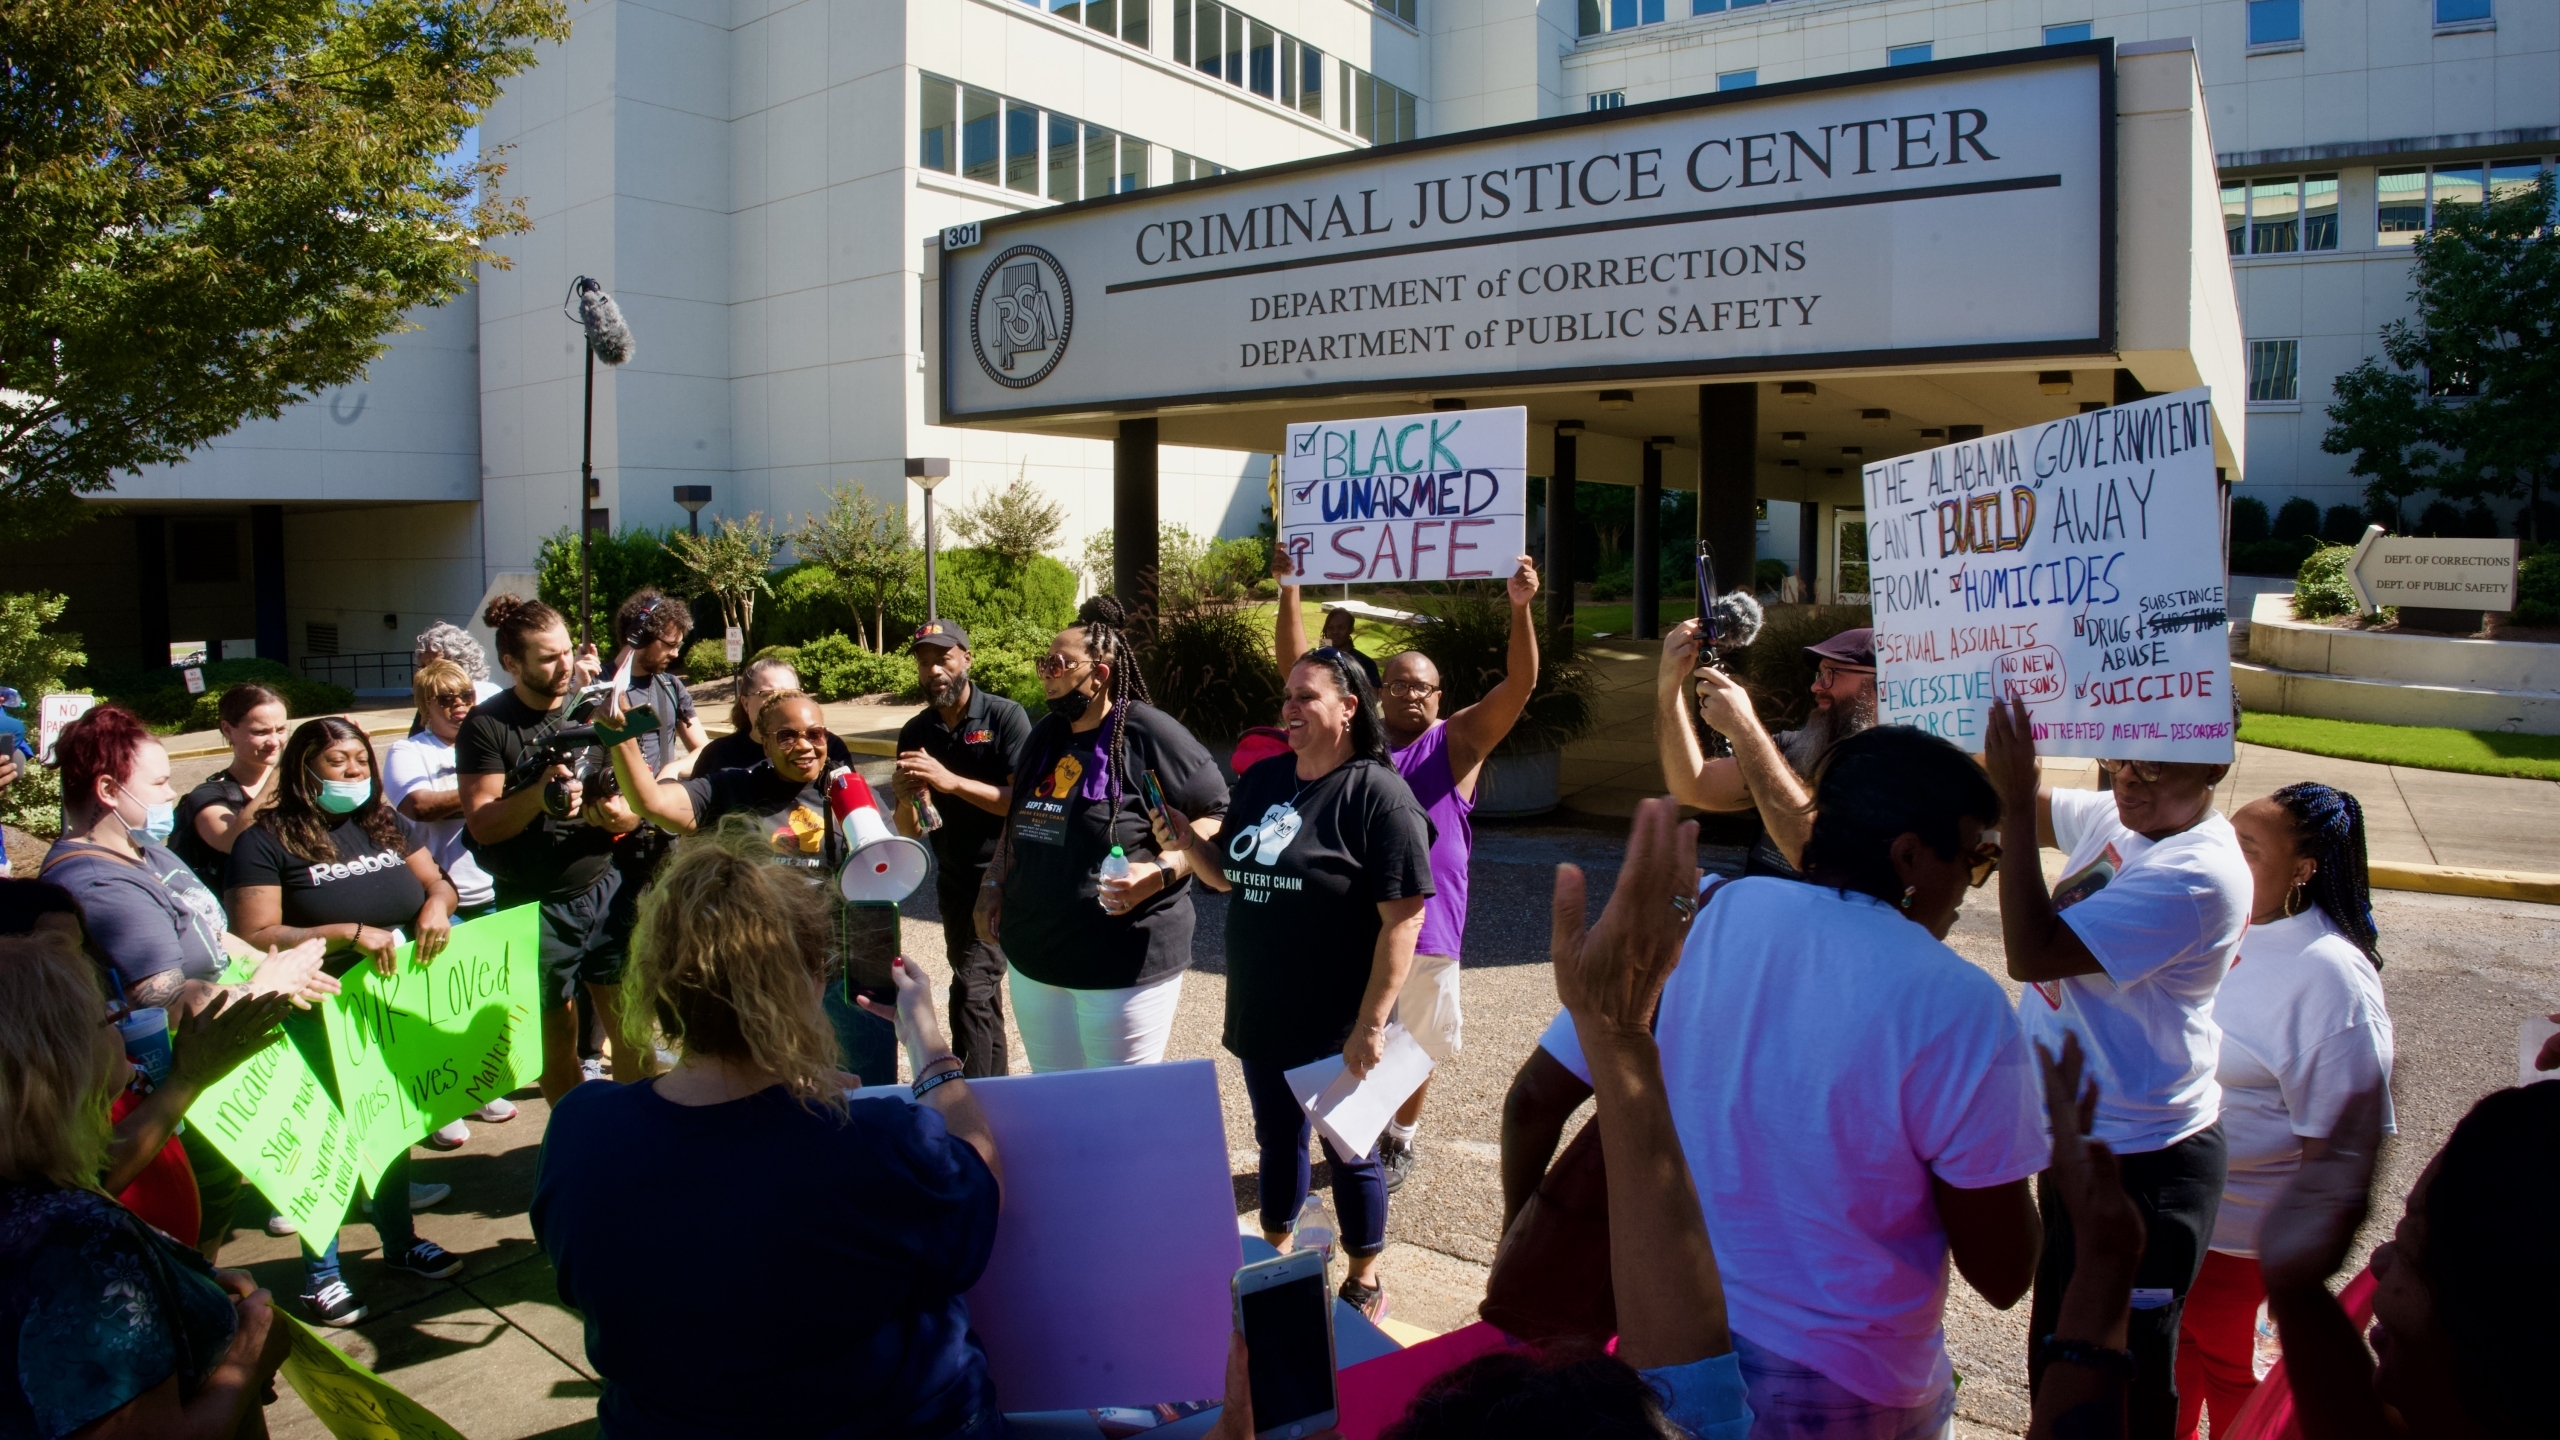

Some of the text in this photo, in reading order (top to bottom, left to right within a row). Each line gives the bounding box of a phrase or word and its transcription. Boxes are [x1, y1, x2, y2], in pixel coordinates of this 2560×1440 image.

[1136, 108, 2000, 266] CRIMINAL JUSTICE CENTER
[948, 227, 979, 247] 301
[1250, 240, 1806, 323] DEPARTMENT of CORRECTIONS
[1240, 295, 1821, 369] DEPARTMENT of PUBLIC SAFETY
[1324, 418, 1462, 479] BLACK
[1865, 399, 2211, 509] THE ALABAMA GOVERNMENT
[1321, 469, 1499, 523] UNARMED
[1868, 509, 1928, 562] CAN'T
[2053, 469, 2155, 544] AWAY
[1323, 519, 1495, 580] SAFE
[2384, 555, 2510, 567] DEPT. OF CORRECTIONS
[1872, 552, 2125, 615] FROM: HOMICIDES
[2139, 587, 2223, 613] SUBSTANCE
[2376, 579, 2509, 593] DEPT. OF PUBLIC SAFETY
[1885, 623, 2038, 664] SEXUAL ASSUALTS
[2086, 615, 2131, 649] DRUG
[2001, 652, 2054, 673] NO NEW
[2101, 641, 2170, 673] ABUSE
[1888, 671, 1994, 711] EXCESSIVE
[2004, 674, 2059, 700] PRISONS
[2089, 670, 2214, 707] SUICIDE
[59, 704, 78, 717] NO
[2112, 722, 2168, 741] MENTAL
[2171, 722, 2231, 742] DISORDERS
[1025, 801, 1063, 813] SEPT 26TH
[309, 849, 406, 886] Reebok
[1244, 872, 1271, 887] EVERY
[1273, 876, 1303, 891] CHAIN
[1244, 888, 1271, 903] RALLY
[344, 940, 510, 1067] OUR Loved
[393, 1058, 459, 1130] Lives
[289, 1187, 319, 1223] the
